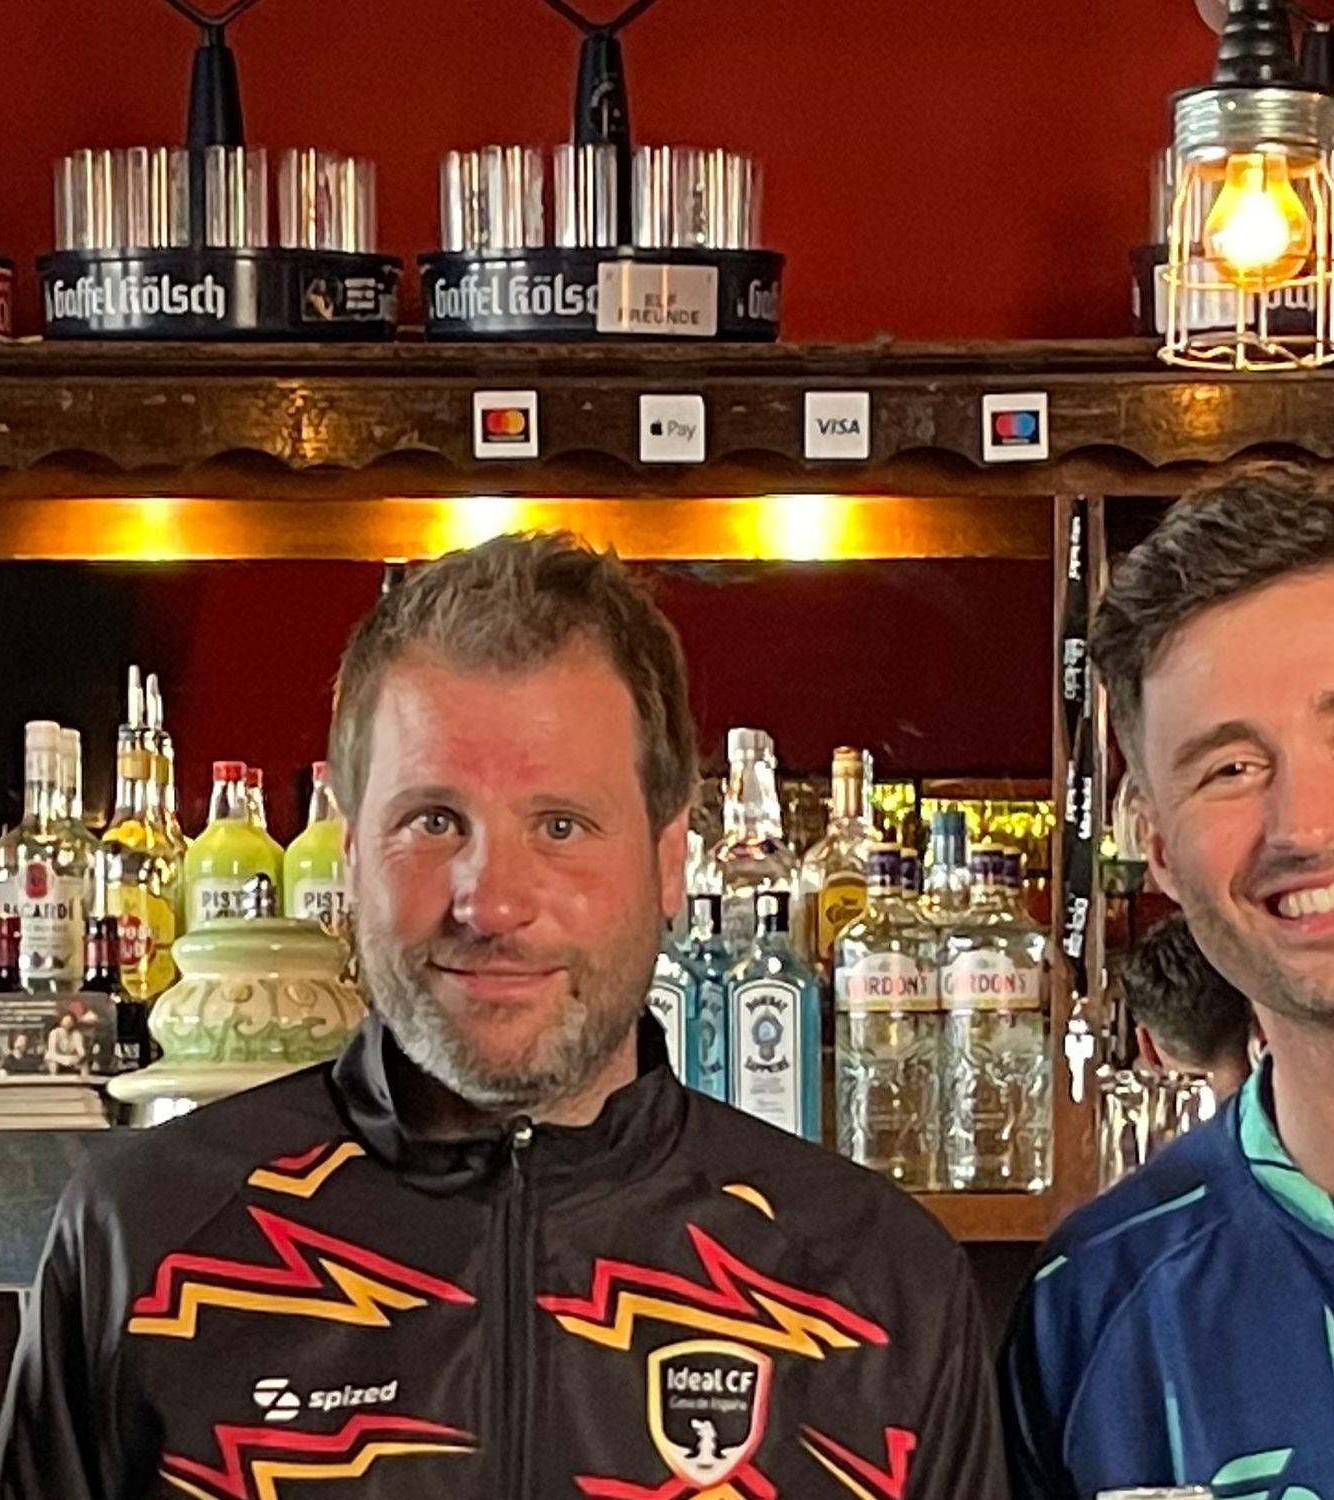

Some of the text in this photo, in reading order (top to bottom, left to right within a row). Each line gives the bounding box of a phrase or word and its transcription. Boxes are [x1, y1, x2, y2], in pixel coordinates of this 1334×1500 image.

[53, 274, 225, 320] Gaffel Kölsch
[434, 275, 502, 321] Gaffel
[666, 419, 697, 440] Pay
[816, 417, 861, 436] VISA
[668, 1366, 755, 1394] Ideal CF
[308, 1379, 399, 1412] spized
